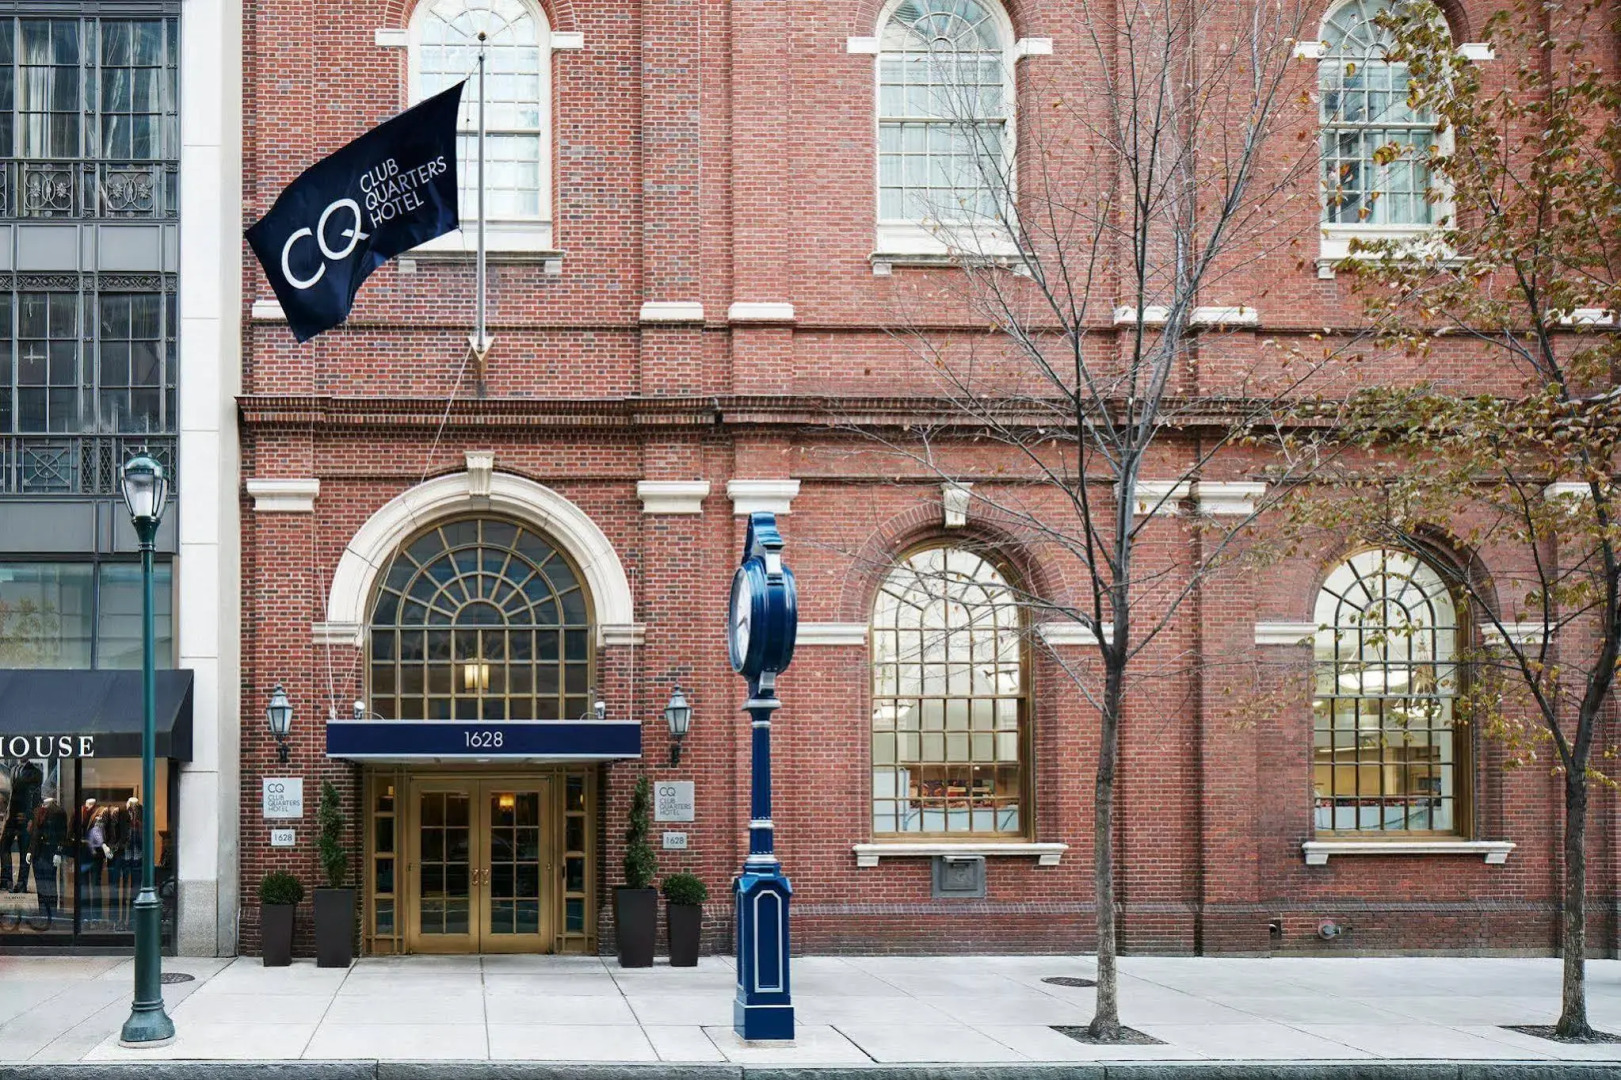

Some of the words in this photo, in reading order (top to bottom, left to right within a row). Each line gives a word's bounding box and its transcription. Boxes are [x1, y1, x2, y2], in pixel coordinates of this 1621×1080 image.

[360, 158, 399, 194] CLUB
[365, 156, 447, 211] QUARTERS
[370, 192, 424, 229] HOTEL
[281, 198, 371, 290] CQ
[0, 735, 95, 758] OUSE
[464, 731, 503, 748] 1628
[268, 783, 284, 793] CQ
[659, 787, 676, 796] CQ
[274, 834, 293, 842] 1628
[666, 837, 684, 845] 1628
